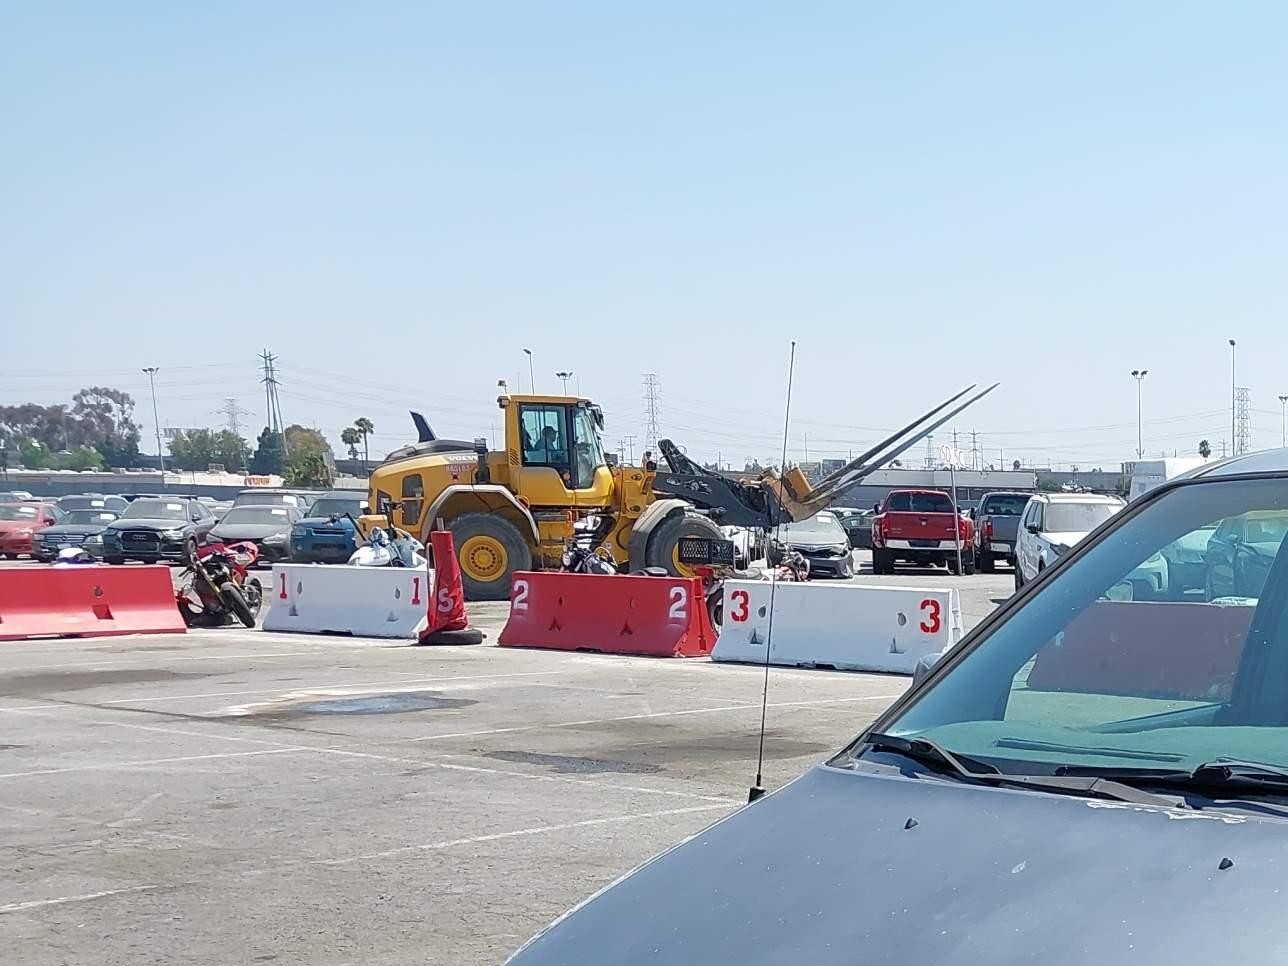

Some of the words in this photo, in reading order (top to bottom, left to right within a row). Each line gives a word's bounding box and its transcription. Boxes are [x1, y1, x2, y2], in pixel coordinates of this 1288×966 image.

[279, 573, 288, 599] 1
[411, 577, 421, 605] 1
[437, 588, 454, 613] S
[513, 580, 529, 610] 2
[668, 586, 688, 619] 2
[730, 590, 749, 622] 3
[920, 599, 941, 633] 3
